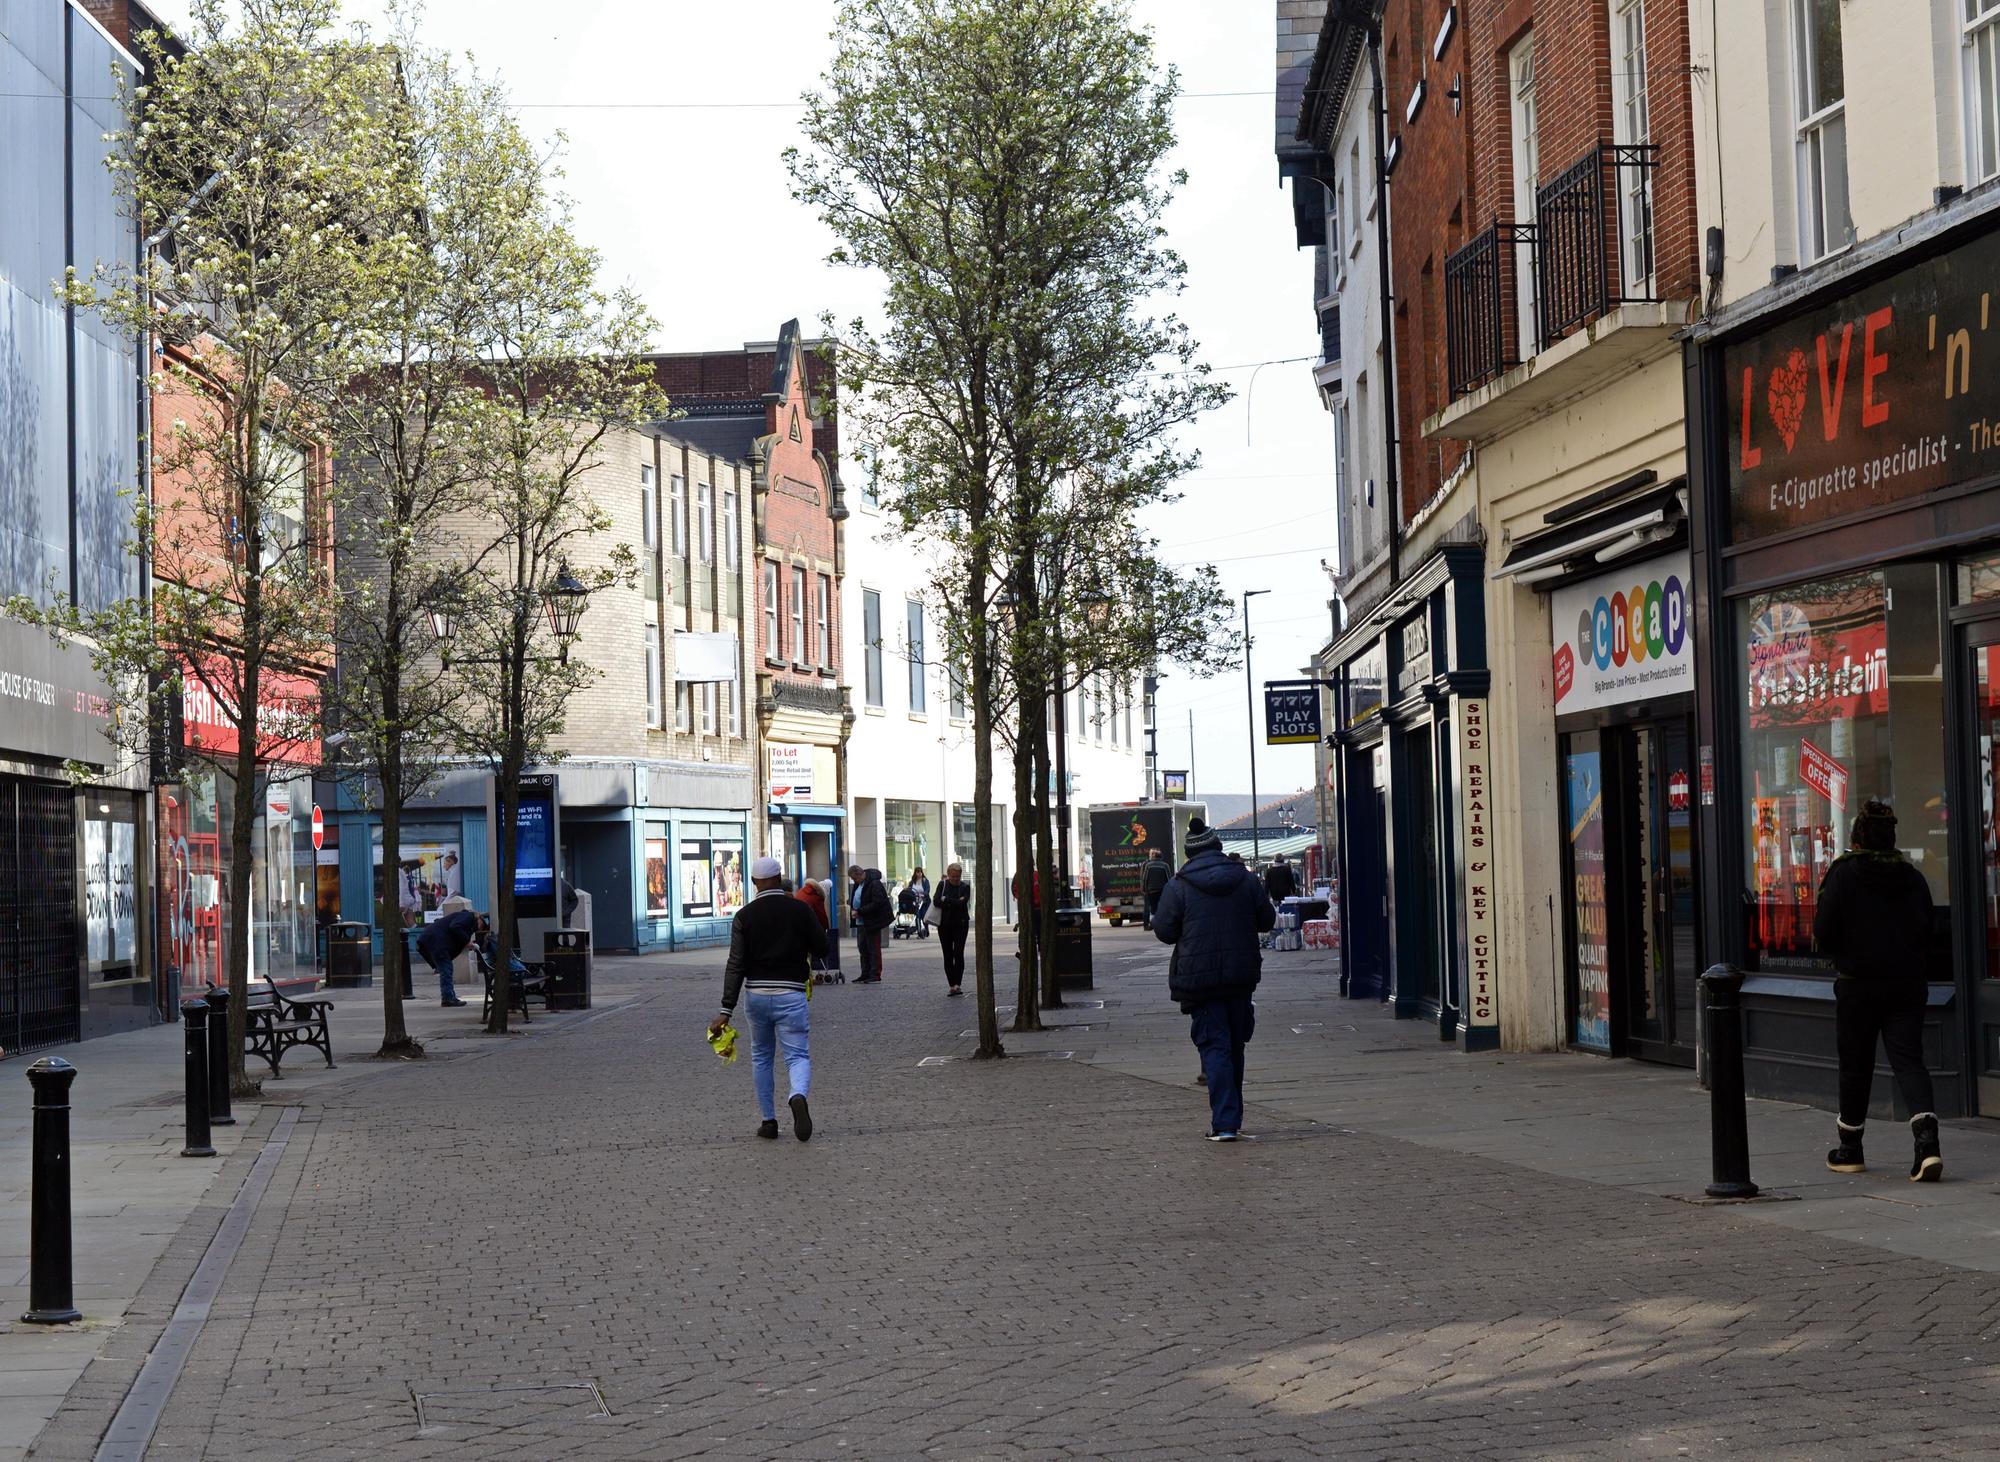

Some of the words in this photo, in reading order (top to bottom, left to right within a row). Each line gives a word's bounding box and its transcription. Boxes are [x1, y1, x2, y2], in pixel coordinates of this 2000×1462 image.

[1770, 458, 1857, 511] E-Cigarette
[1863, 435, 1947, 489] specialist
[1597, 590, 1681, 658] Cheap
[1750, 631, 1808, 675] Signature
[0, 671, 21, 698] HOUSE
[22, 677, 32, 701] OF
[33, 679, 55, 706] FRASER
[1625, 674, 1637, 686] Prices
[1640, 672, 1650, 683] Most
[1650, 667, 1668, 681] Products
[1669, 665, 1681, 678] Under
[1272, 722, 1316, 735] SLOTS
[1275, 710, 1310, 722] PLAY
[1467, 703, 1481, 750] SHOE
[772, 748, 782, 757] To
[784, 748, 797, 757] Let
[1803, 746, 1823, 767] SPECIAL
[1824, 761, 1846, 784] OPENING
[1808, 764, 1839, 797] OFFERS
[1468, 764, 1485, 847] REPAIRS
[1471, 862, 1487, 872] &
[1472, 886, 1487, 920] KEY
[1474, 935, 1490, 1018] CUTTING
